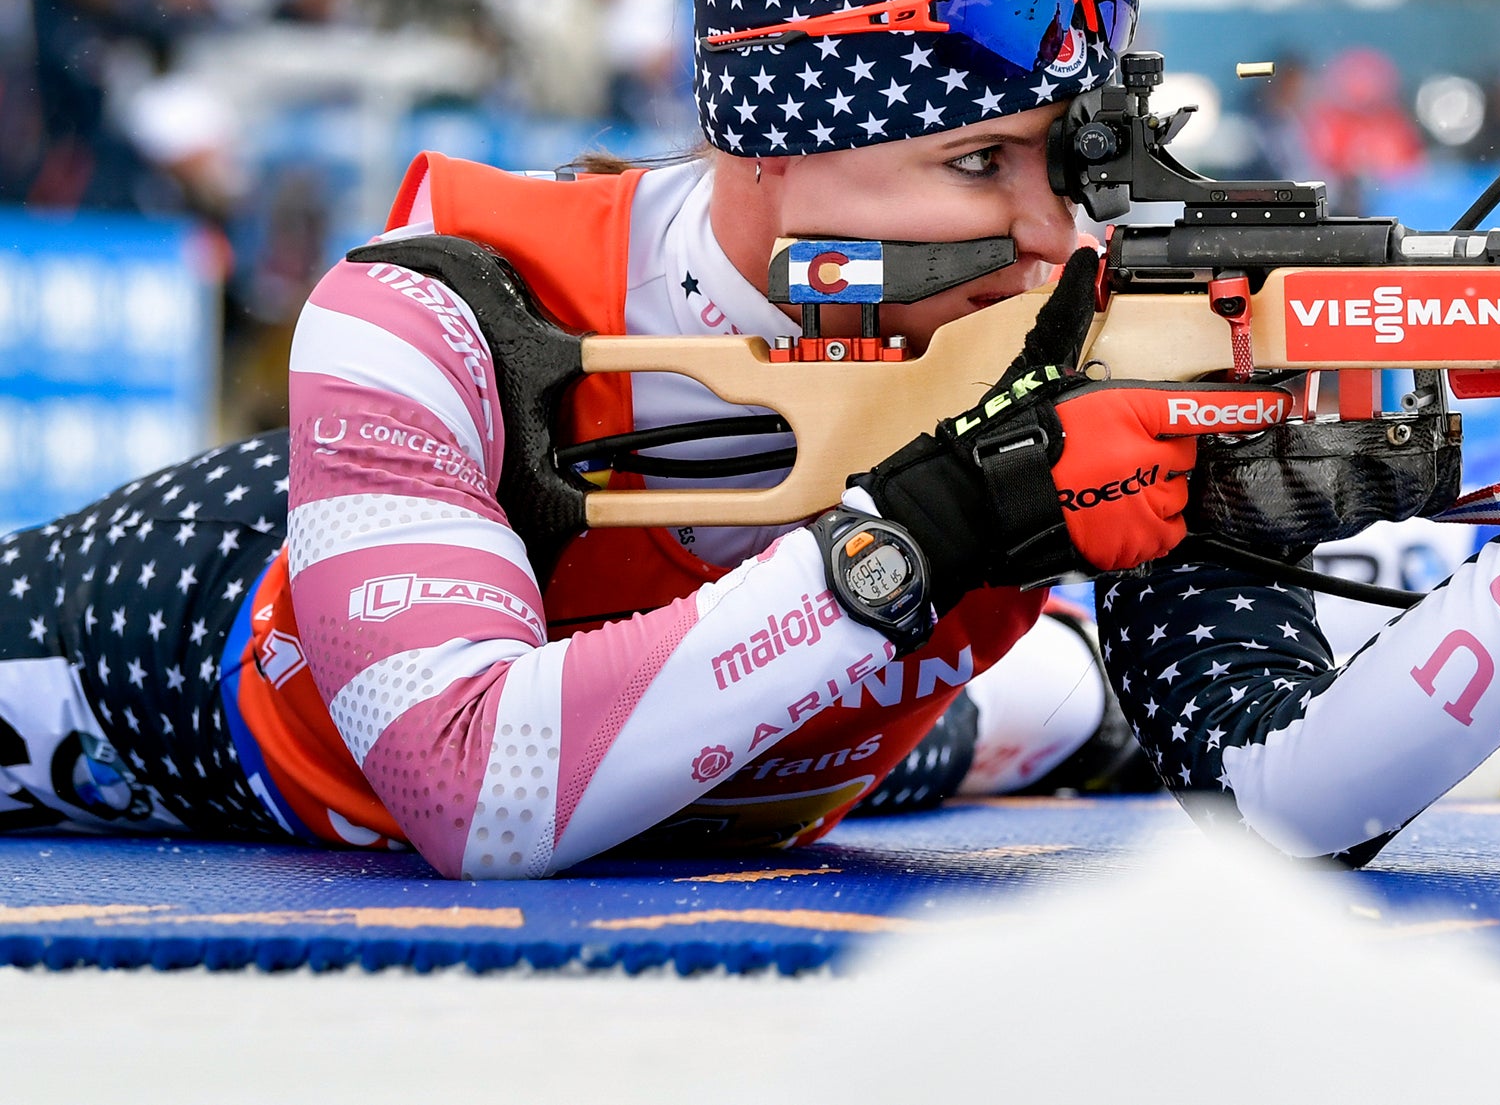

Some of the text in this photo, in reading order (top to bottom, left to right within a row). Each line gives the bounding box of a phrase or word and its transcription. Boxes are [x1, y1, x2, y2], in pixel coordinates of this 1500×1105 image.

[1050, 59, 1082, 73] BIATHLON
[954, 364, 1061, 437] LEKI
[420, 582, 545, 642] LAPUA
[710, 588, 843, 691] maloja
